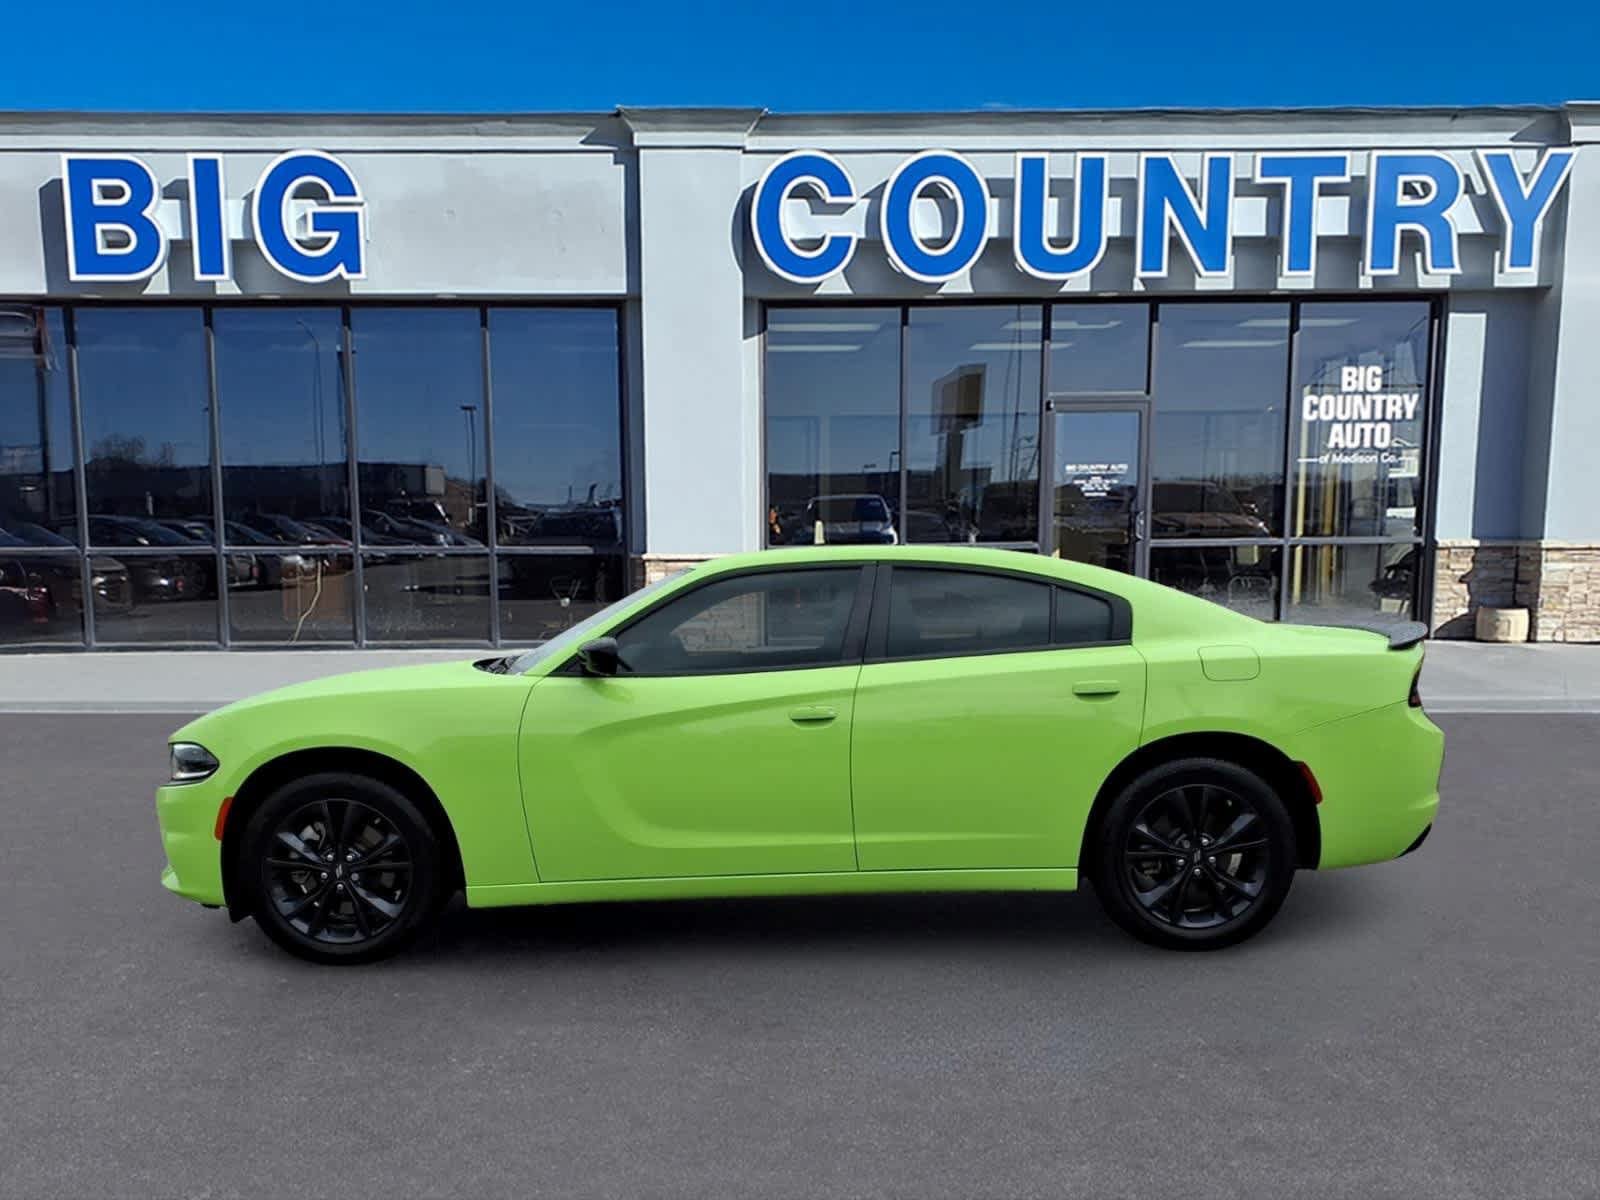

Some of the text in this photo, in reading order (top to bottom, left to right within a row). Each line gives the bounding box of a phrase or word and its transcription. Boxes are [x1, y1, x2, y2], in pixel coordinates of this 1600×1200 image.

[60, 148, 1575, 284] BIG COUNTRY
[1341, 366, 1382, 392] BIG
[1303, 394, 1419, 421] COUNTRY
[1327, 422, 1392, 449] AUTO
[1319, 452, 1330, 464] of
